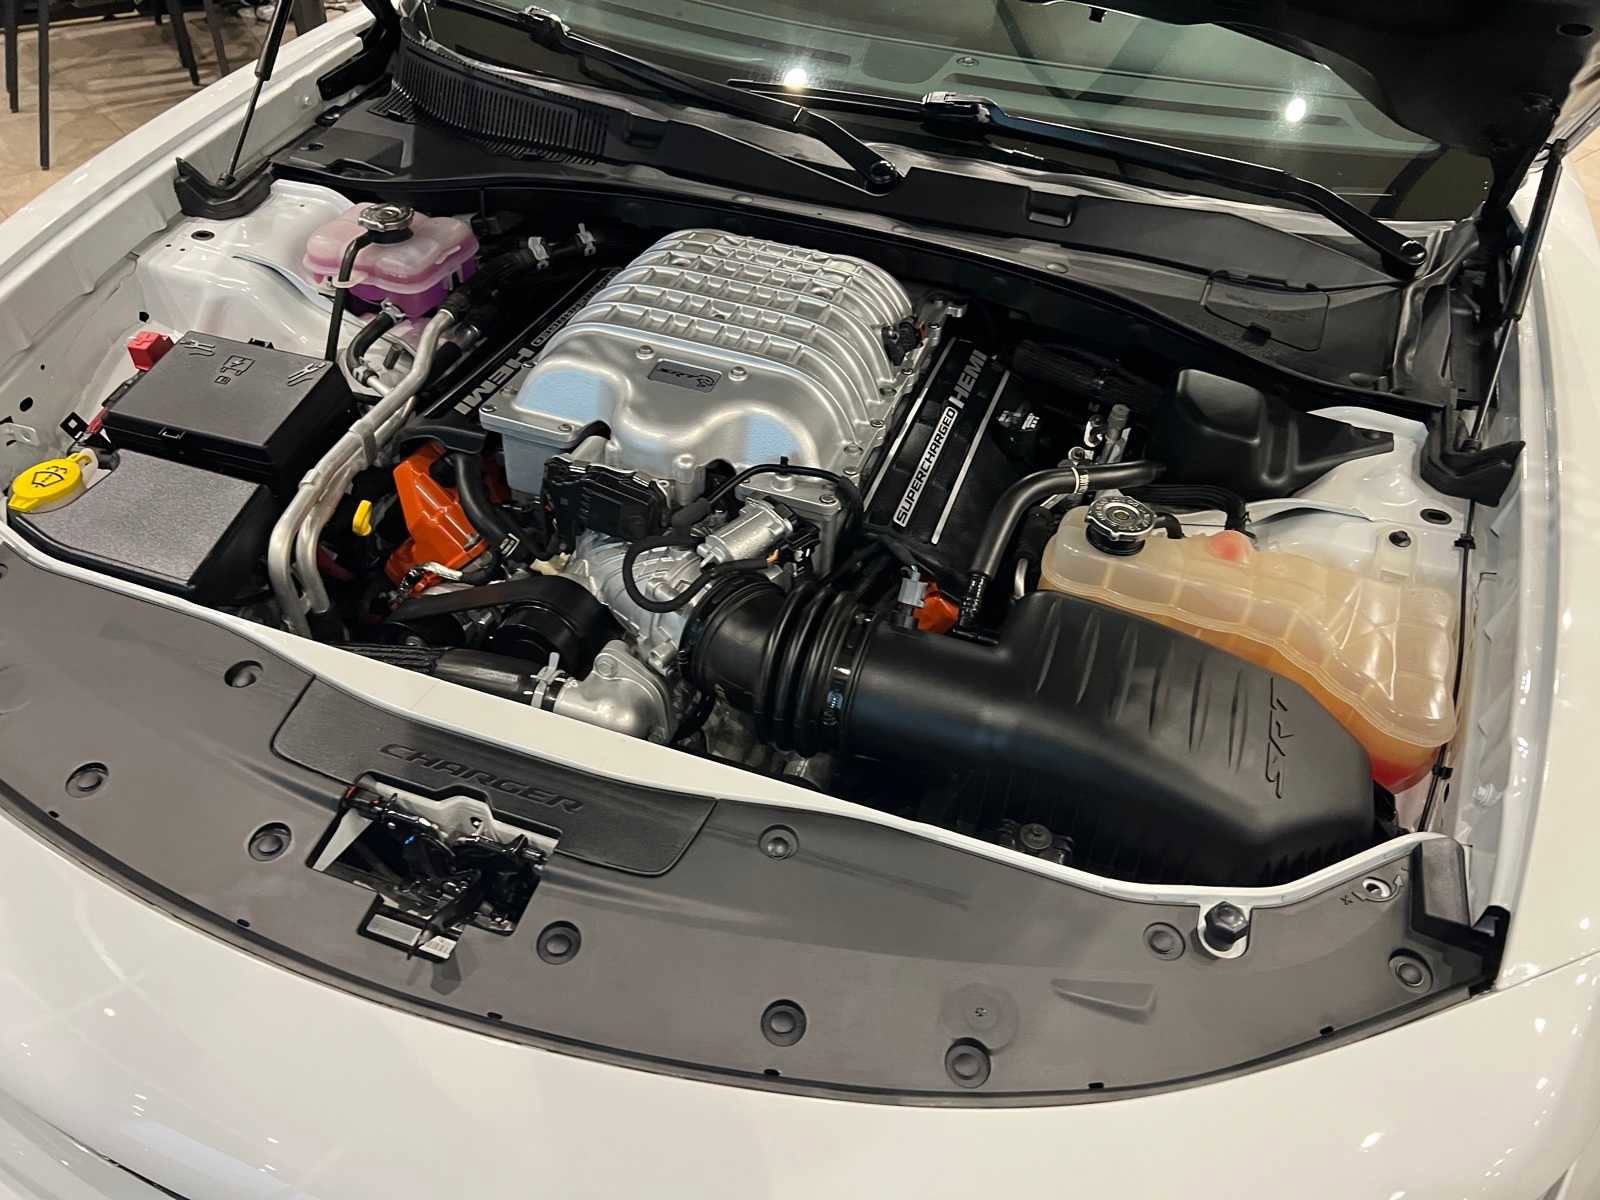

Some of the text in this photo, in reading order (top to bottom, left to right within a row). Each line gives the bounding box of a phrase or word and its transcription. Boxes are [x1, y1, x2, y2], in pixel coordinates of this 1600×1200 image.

[454, 348, 535, 415] HEMI
[894, 350, 988, 527] SUPERCHARGED HEMI
[379, 744, 584, 814] CHARGER
[1265, 677, 1294, 799] SRT
